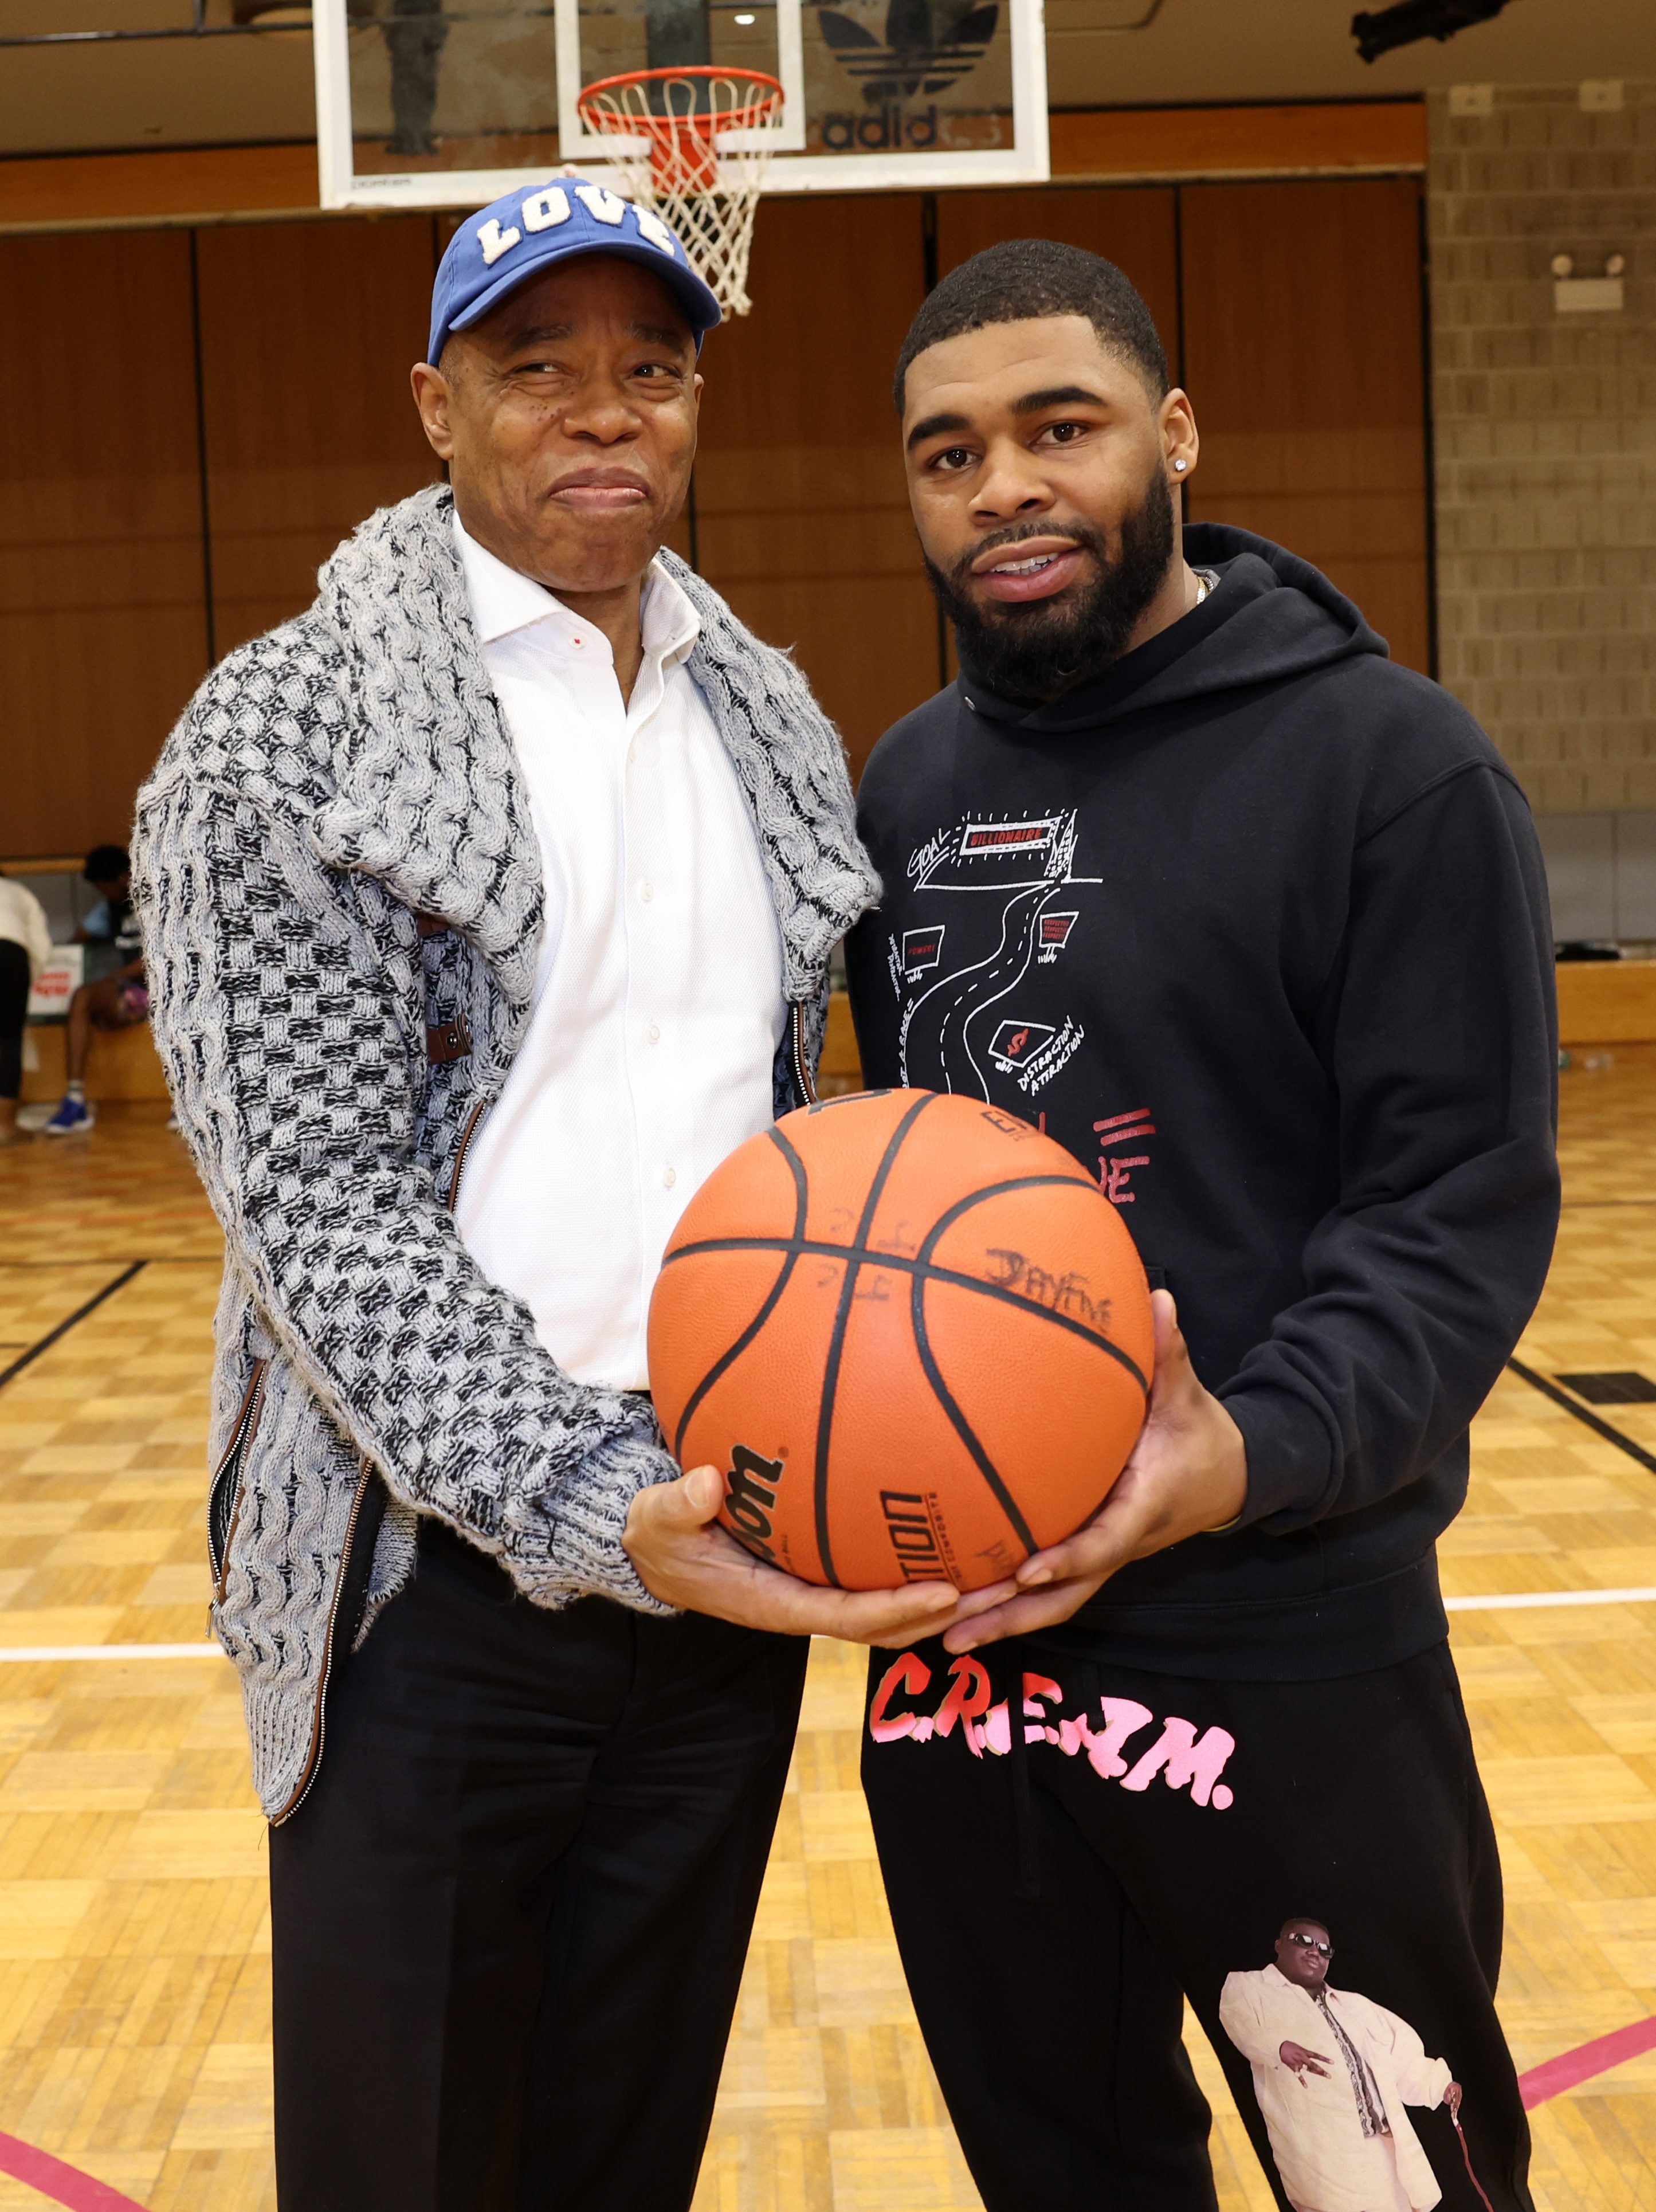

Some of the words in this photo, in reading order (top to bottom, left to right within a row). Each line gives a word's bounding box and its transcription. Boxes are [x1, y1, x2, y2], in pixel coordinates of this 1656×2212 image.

[823, 104, 1002, 150] adid
[477, 185, 675, 265] LOVE
[907, 827, 951, 877] GOAL
[970, 827, 1043, 847] BILLIONAIRE
[1017, 1015, 1074, 1092] DISTRACTION
[1031, 1024, 1085, 1097] ATTRACTION
[880, 1491, 945, 1583] TION
